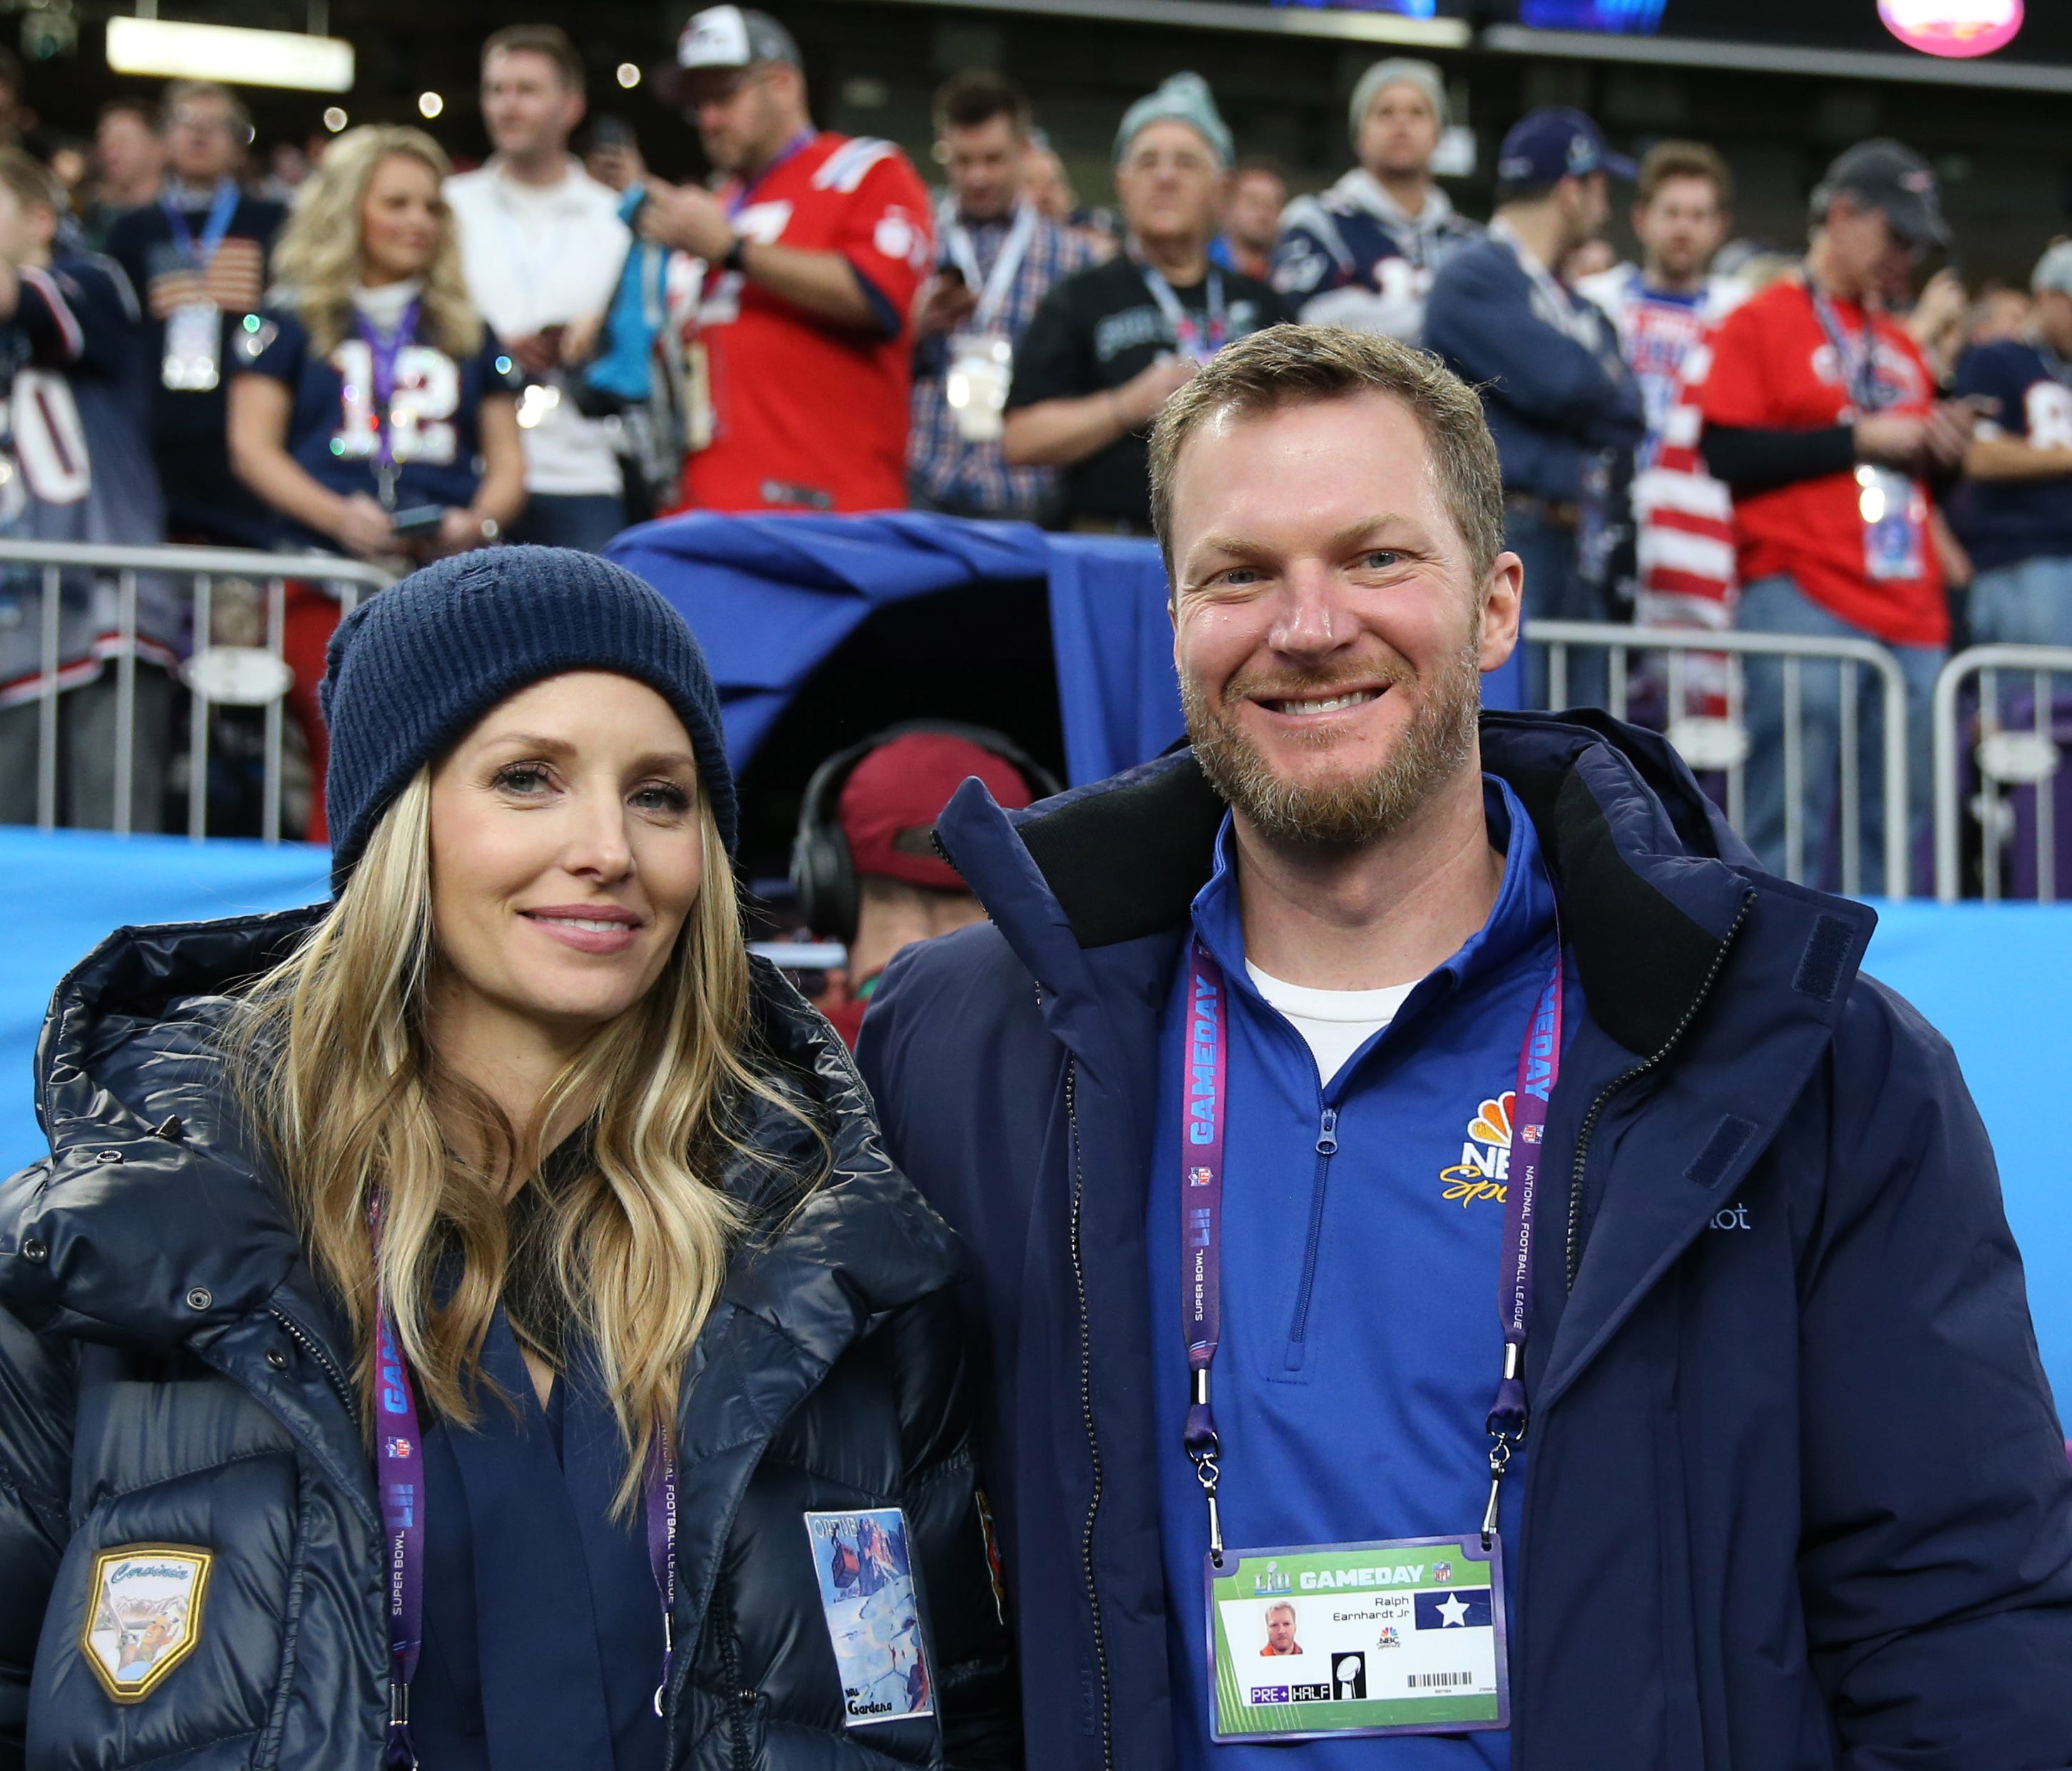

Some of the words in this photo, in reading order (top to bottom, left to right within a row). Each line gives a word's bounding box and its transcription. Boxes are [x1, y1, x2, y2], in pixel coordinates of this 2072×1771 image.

[329, 338, 461, 465] 12
[1190, 974, 1217, 1145] GAMEDAY
[1522, 1165, 1534, 1219] NATIONAL
[1517, 1222, 1529, 1283] FOOTBALL
[1195, 1283, 1204, 1321] SUPER
[1513, 1285, 1524, 1330] LEAGUE
[666, 1484, 677, 1550] FOOTBALL
[394, 1530, 405, 1569] BOWL
[393, 1571, 404, 1616] SUPER
[667, 1554, 675, 1603] LEAGUE
[1300, 1564, 1424, 1589] GAMEDAY
[1333, 1610, 1394, 1621] Earnhardt
[1397, 1608, 1410, 1618] Jr
[1375, 1596, 1410, 1607] Ralph
[847, 1700, 893, 1715] Gardena
[1293, 1685, 1329, 1700] HALF
